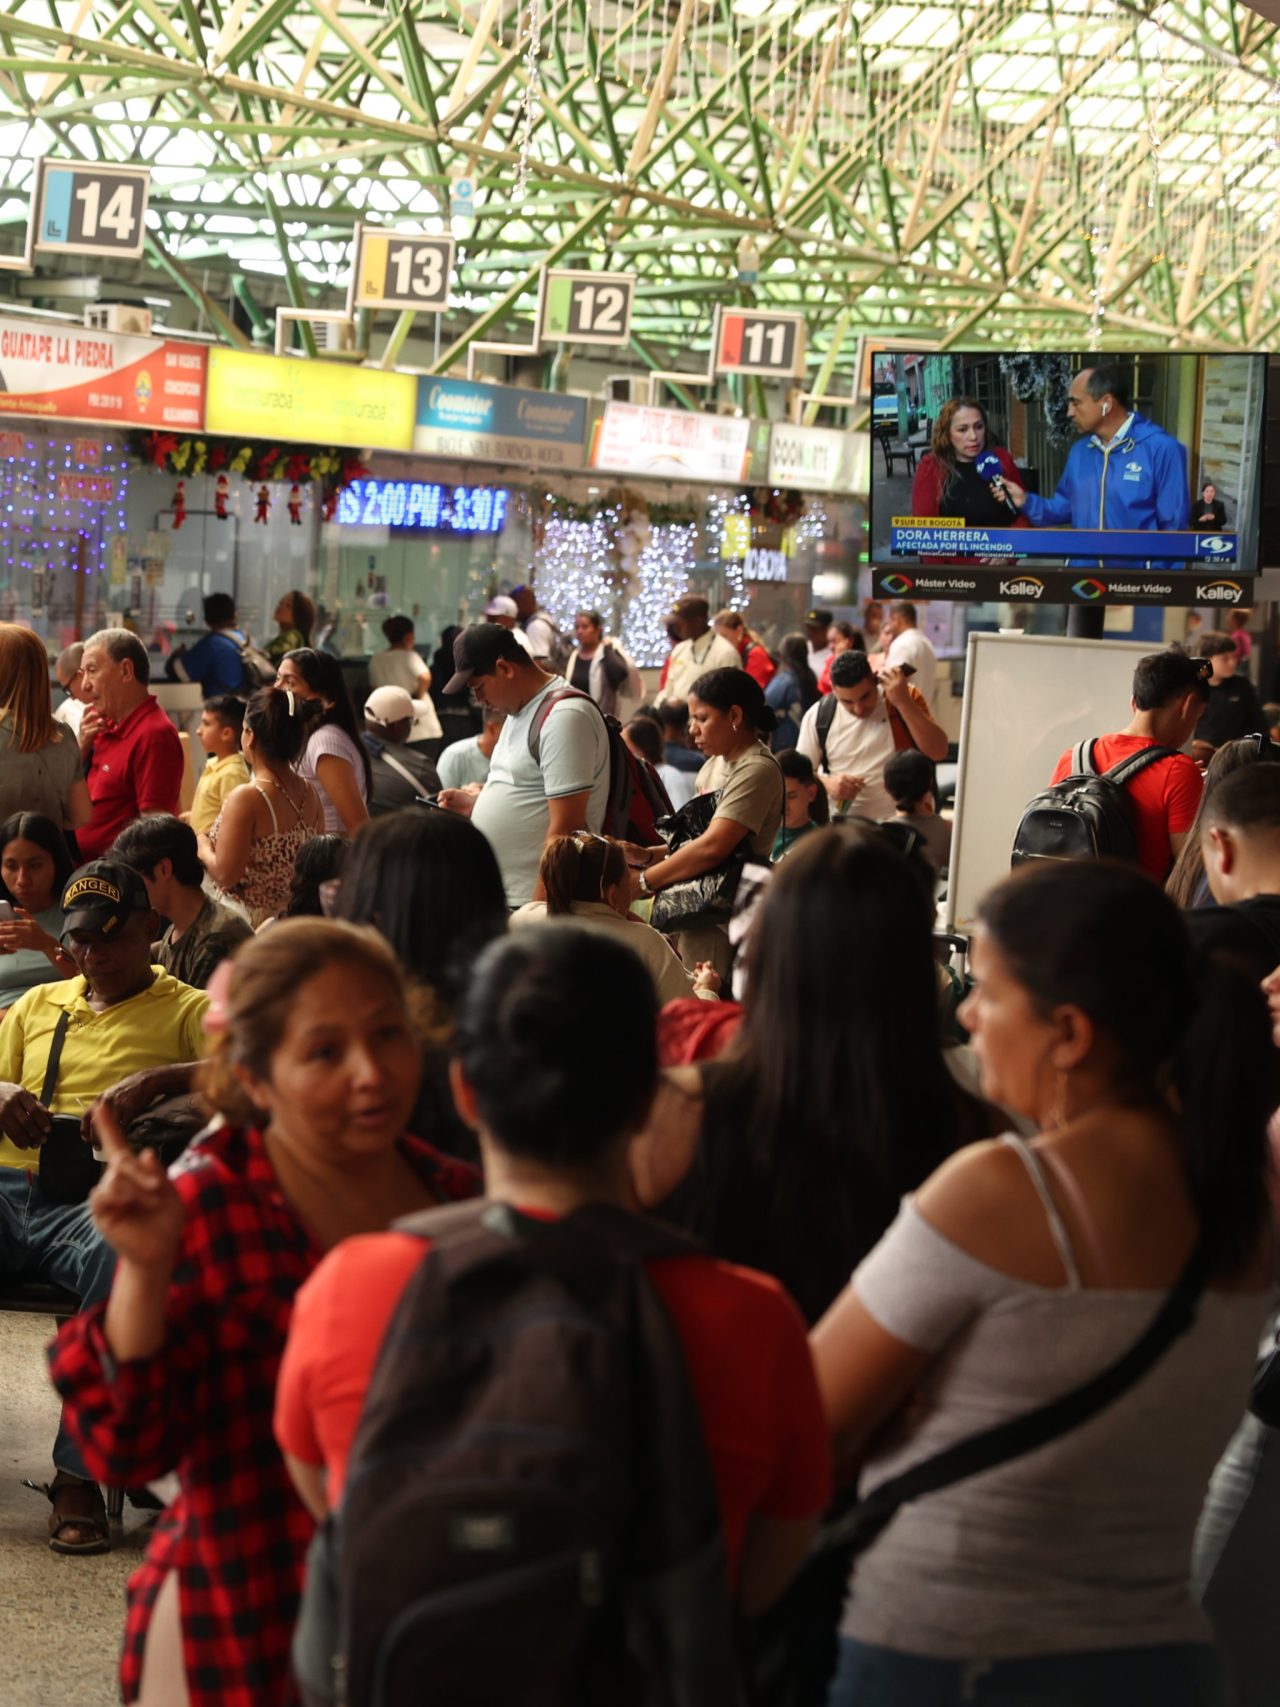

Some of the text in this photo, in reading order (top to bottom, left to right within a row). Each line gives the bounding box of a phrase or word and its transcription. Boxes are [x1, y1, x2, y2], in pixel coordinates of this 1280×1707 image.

[76, 181, 135, 239] 14
[390, 246, 444, 296] 13
[574, 286, 625, 331] 12
[1, 331, 52, 362] GUATAPE
[57, 336, 70, 363] LA
[75, 340, 114, 368] PIEDRA
[745, 323, 786, 364] 11
[900, 518, 916, 527] SUR
[918, 519, 928, 527] DE
[896, 530, 990, 542] DORA HERRERA
[896, 542, 1013, 552] AFECTADA POR EL INCENDIO
[915, 578, 976, 589] Máster Video
[999, 581, 1045, 599] Kalley
[1108, 582, 1172, 594] Máster Video
[1196, 586, 1243, 603] Kalley
